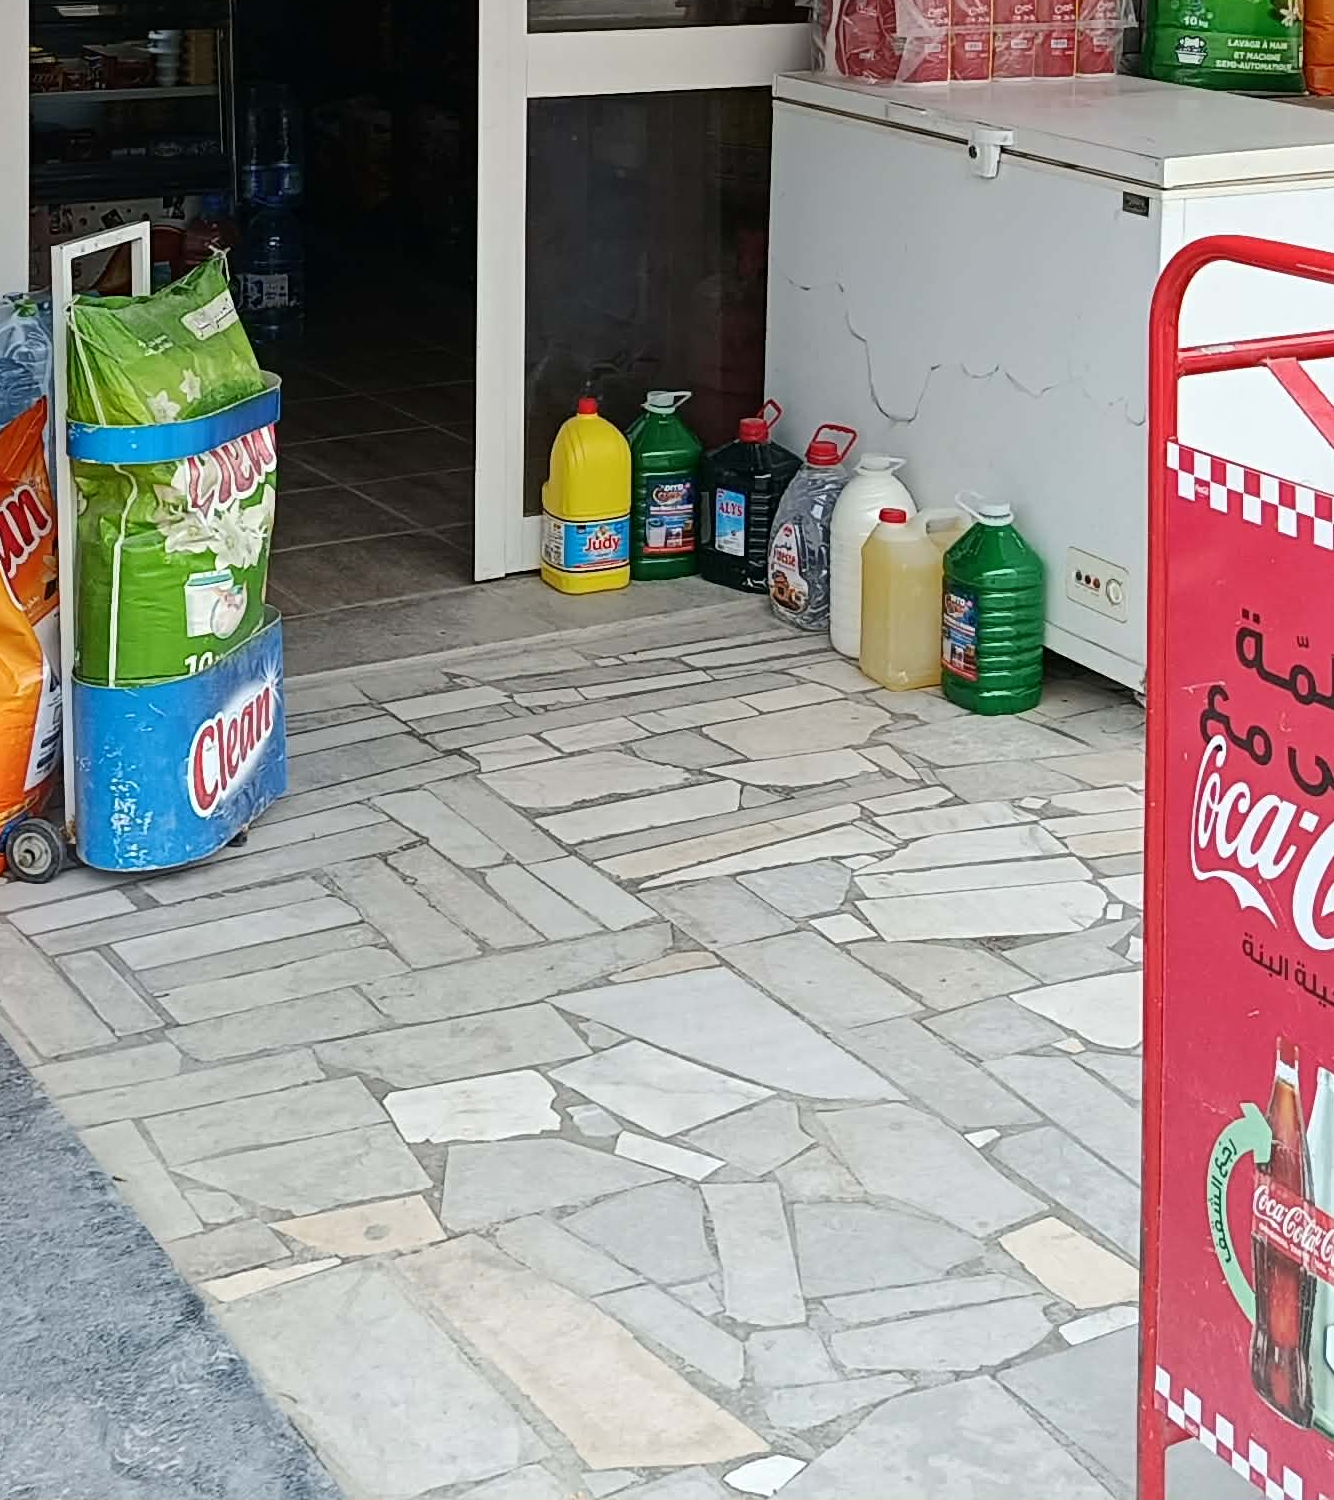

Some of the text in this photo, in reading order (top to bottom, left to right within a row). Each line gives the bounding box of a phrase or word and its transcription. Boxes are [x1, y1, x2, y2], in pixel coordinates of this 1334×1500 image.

[1183, 15, 1197, 26] 10
[719, 501, 743, 517] ALYS
[584, 534, 620, 553] Judy
[1199, 684, 1273, 765] مع
[192, 687, 273, 812] Clean
[1242, 932, 1289, 981] البنة
[1252, 1185, 1318, 1254] Coca-Cola
